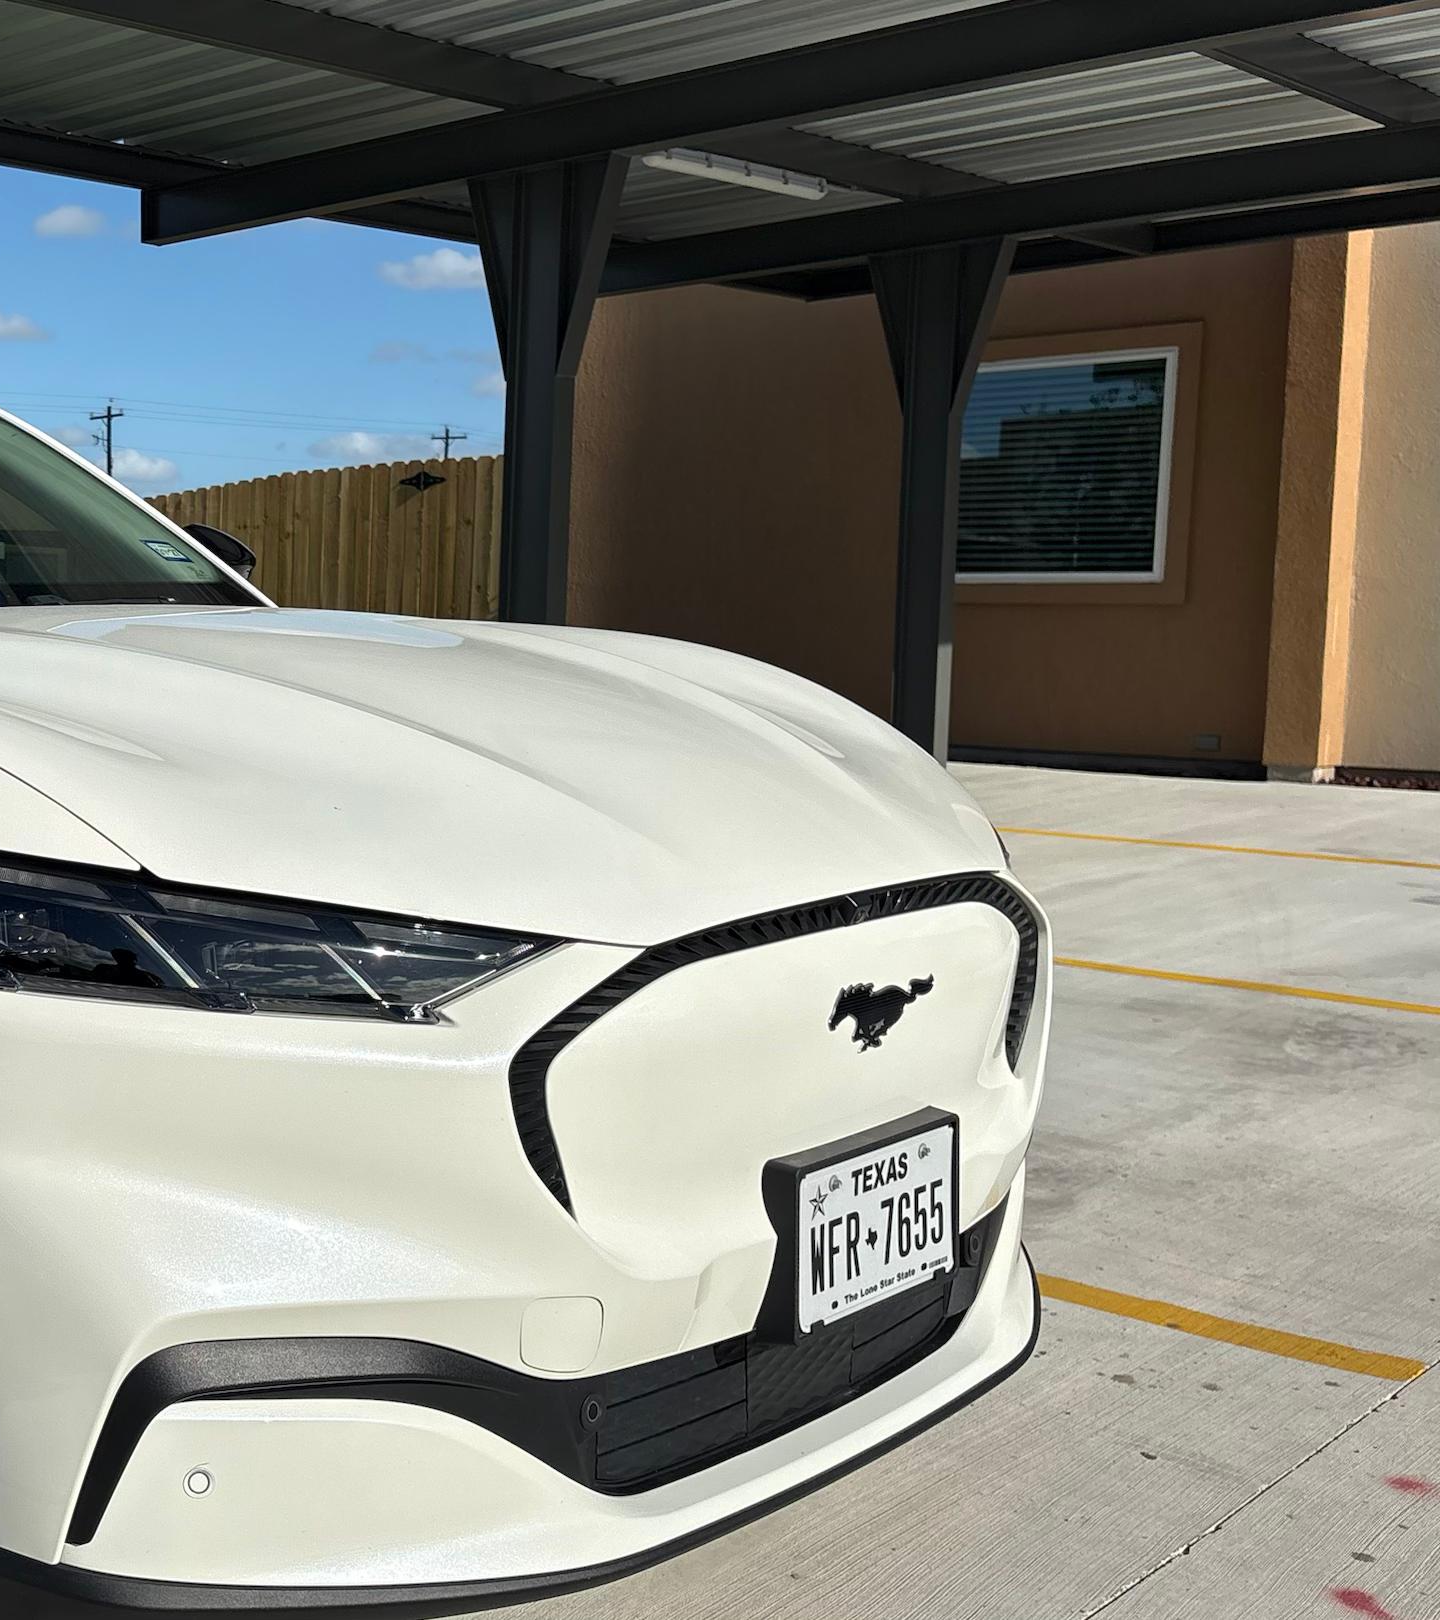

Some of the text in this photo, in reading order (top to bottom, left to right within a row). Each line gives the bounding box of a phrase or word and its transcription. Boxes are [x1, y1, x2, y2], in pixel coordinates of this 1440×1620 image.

[851, 1152, 908, 1197] TEXAS
[810, 1178, 944, 1296] WFR 7655
[844, 1268, 916, 1304] The Lone Star State
